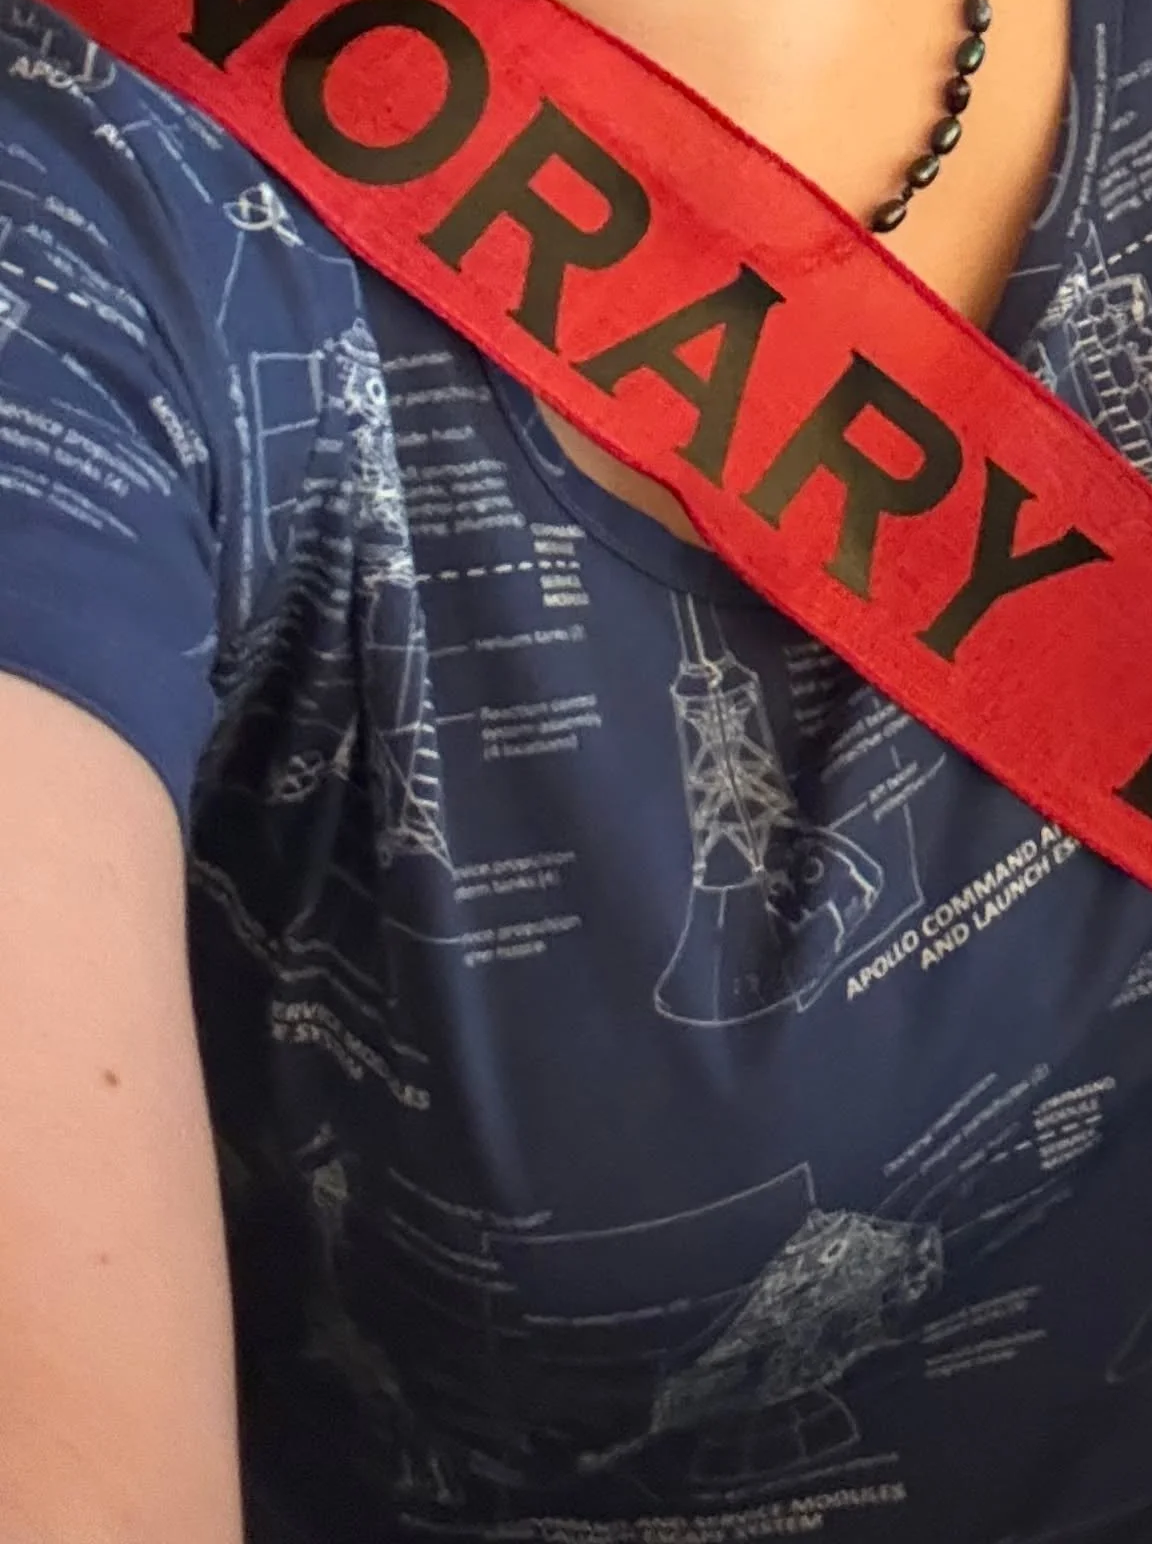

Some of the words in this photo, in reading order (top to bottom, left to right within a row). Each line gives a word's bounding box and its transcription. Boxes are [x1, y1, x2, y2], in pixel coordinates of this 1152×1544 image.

[847, 930, 920, 1001] APOLLO
[922, 840, 1037, 937] COMMAND
[921, 922, 970, 970] AND
[973, 856, 1050, 931] LAUNCH
